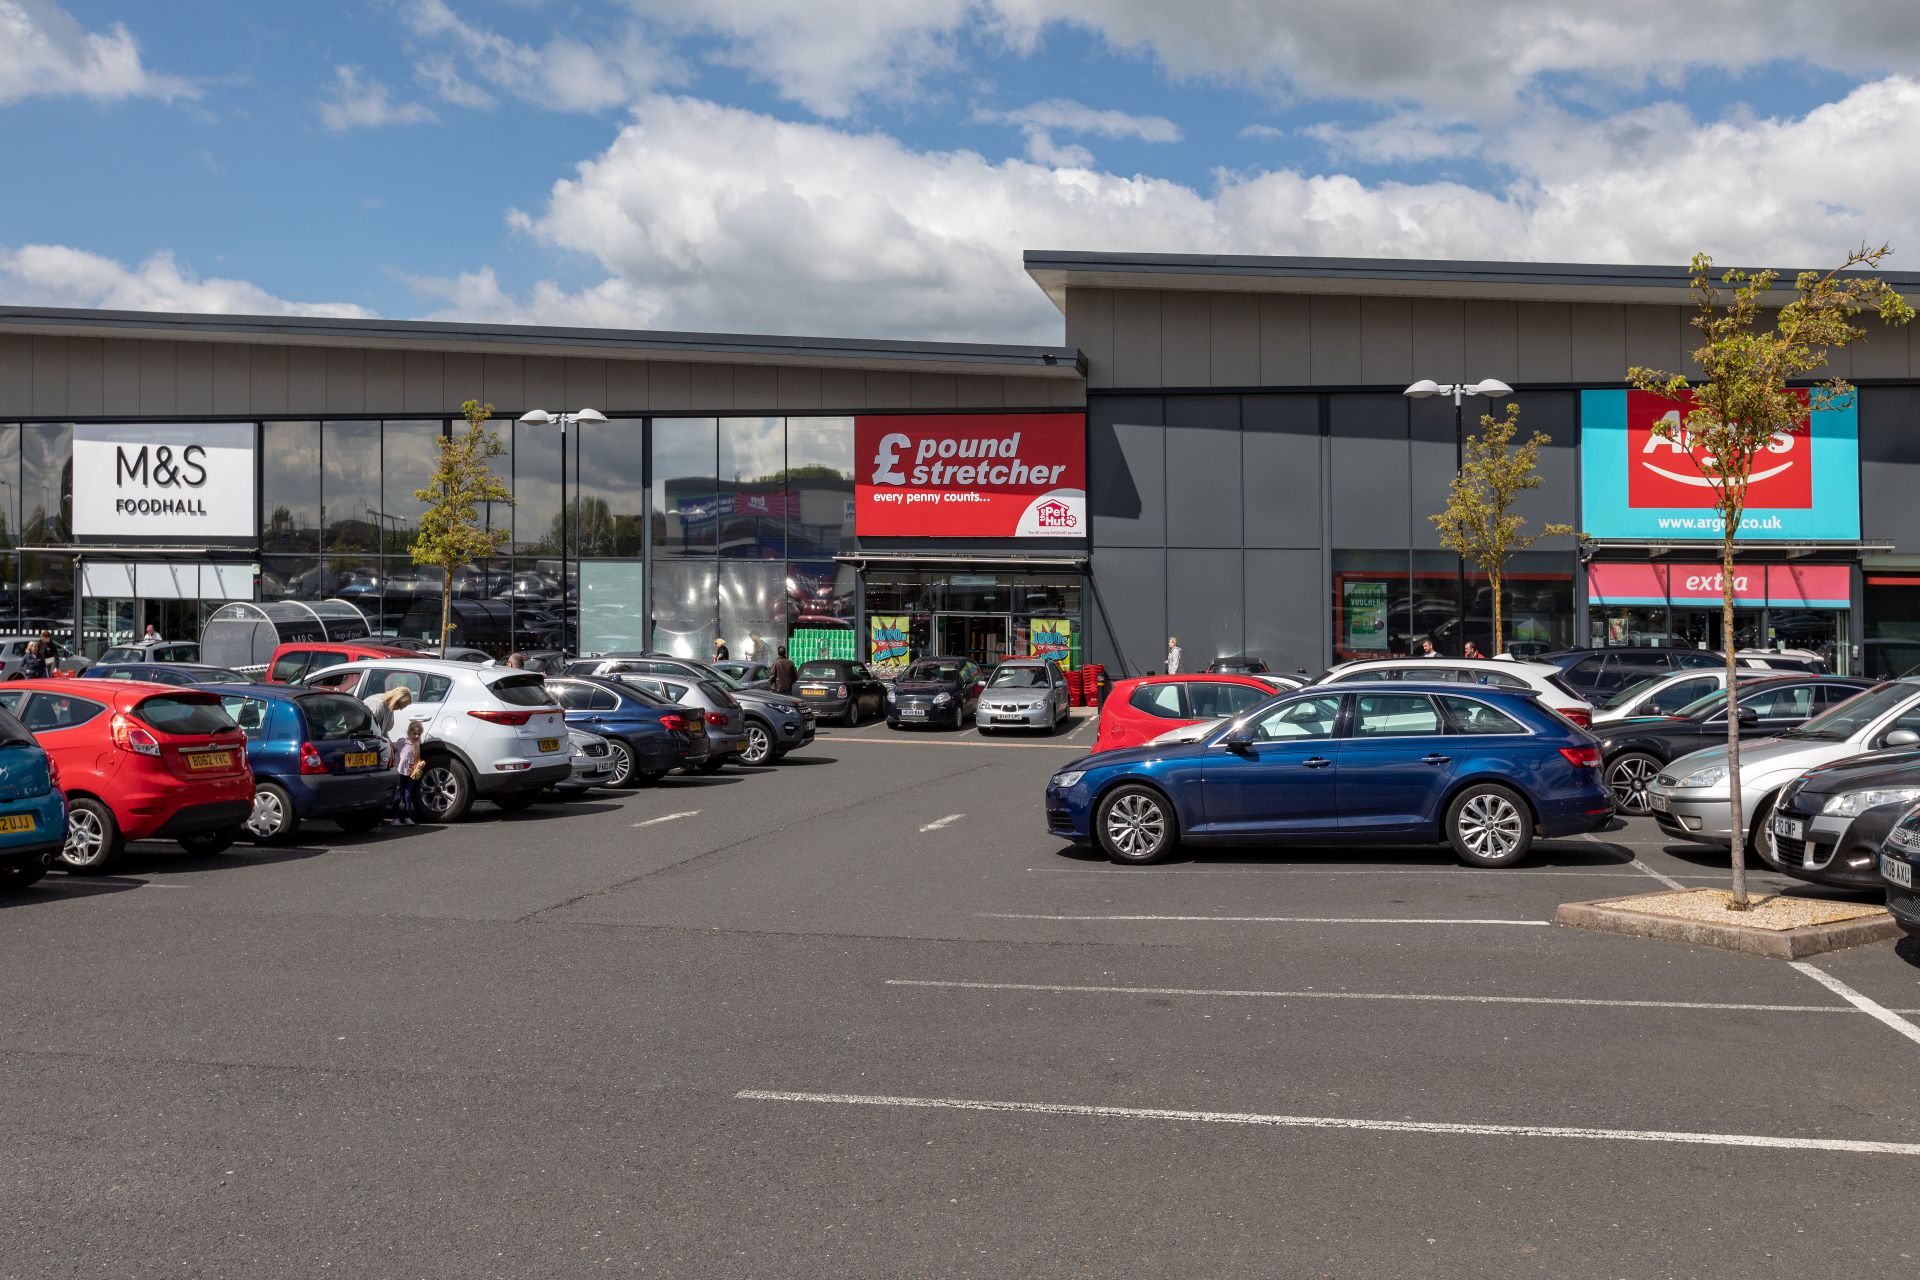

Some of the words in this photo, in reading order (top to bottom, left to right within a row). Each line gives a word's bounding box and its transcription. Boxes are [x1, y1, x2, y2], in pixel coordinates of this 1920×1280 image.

[915, 432, 1021, 464] pound
[116, 445, 207, 488] M&S
[872, 433, 911, 485] £
[911, 460, 1066, 485] stretcher
[873, 492, 903, 503] every
[906, 492, 940, 504] penny
[116, 499, 207, 515] FOODHALL
[1045, 506, 1065, 516] Pet
[1045, 516, 1065, 525] Hut
[1658, 516, 1782, 532] www.argo.co.uk
[1685, 572, 1748, 591] exta
[192, 756, 213, 766] BD62
[9, 816, 30, 829] UJJ
[1896, 863, 1910, 883] AXU
